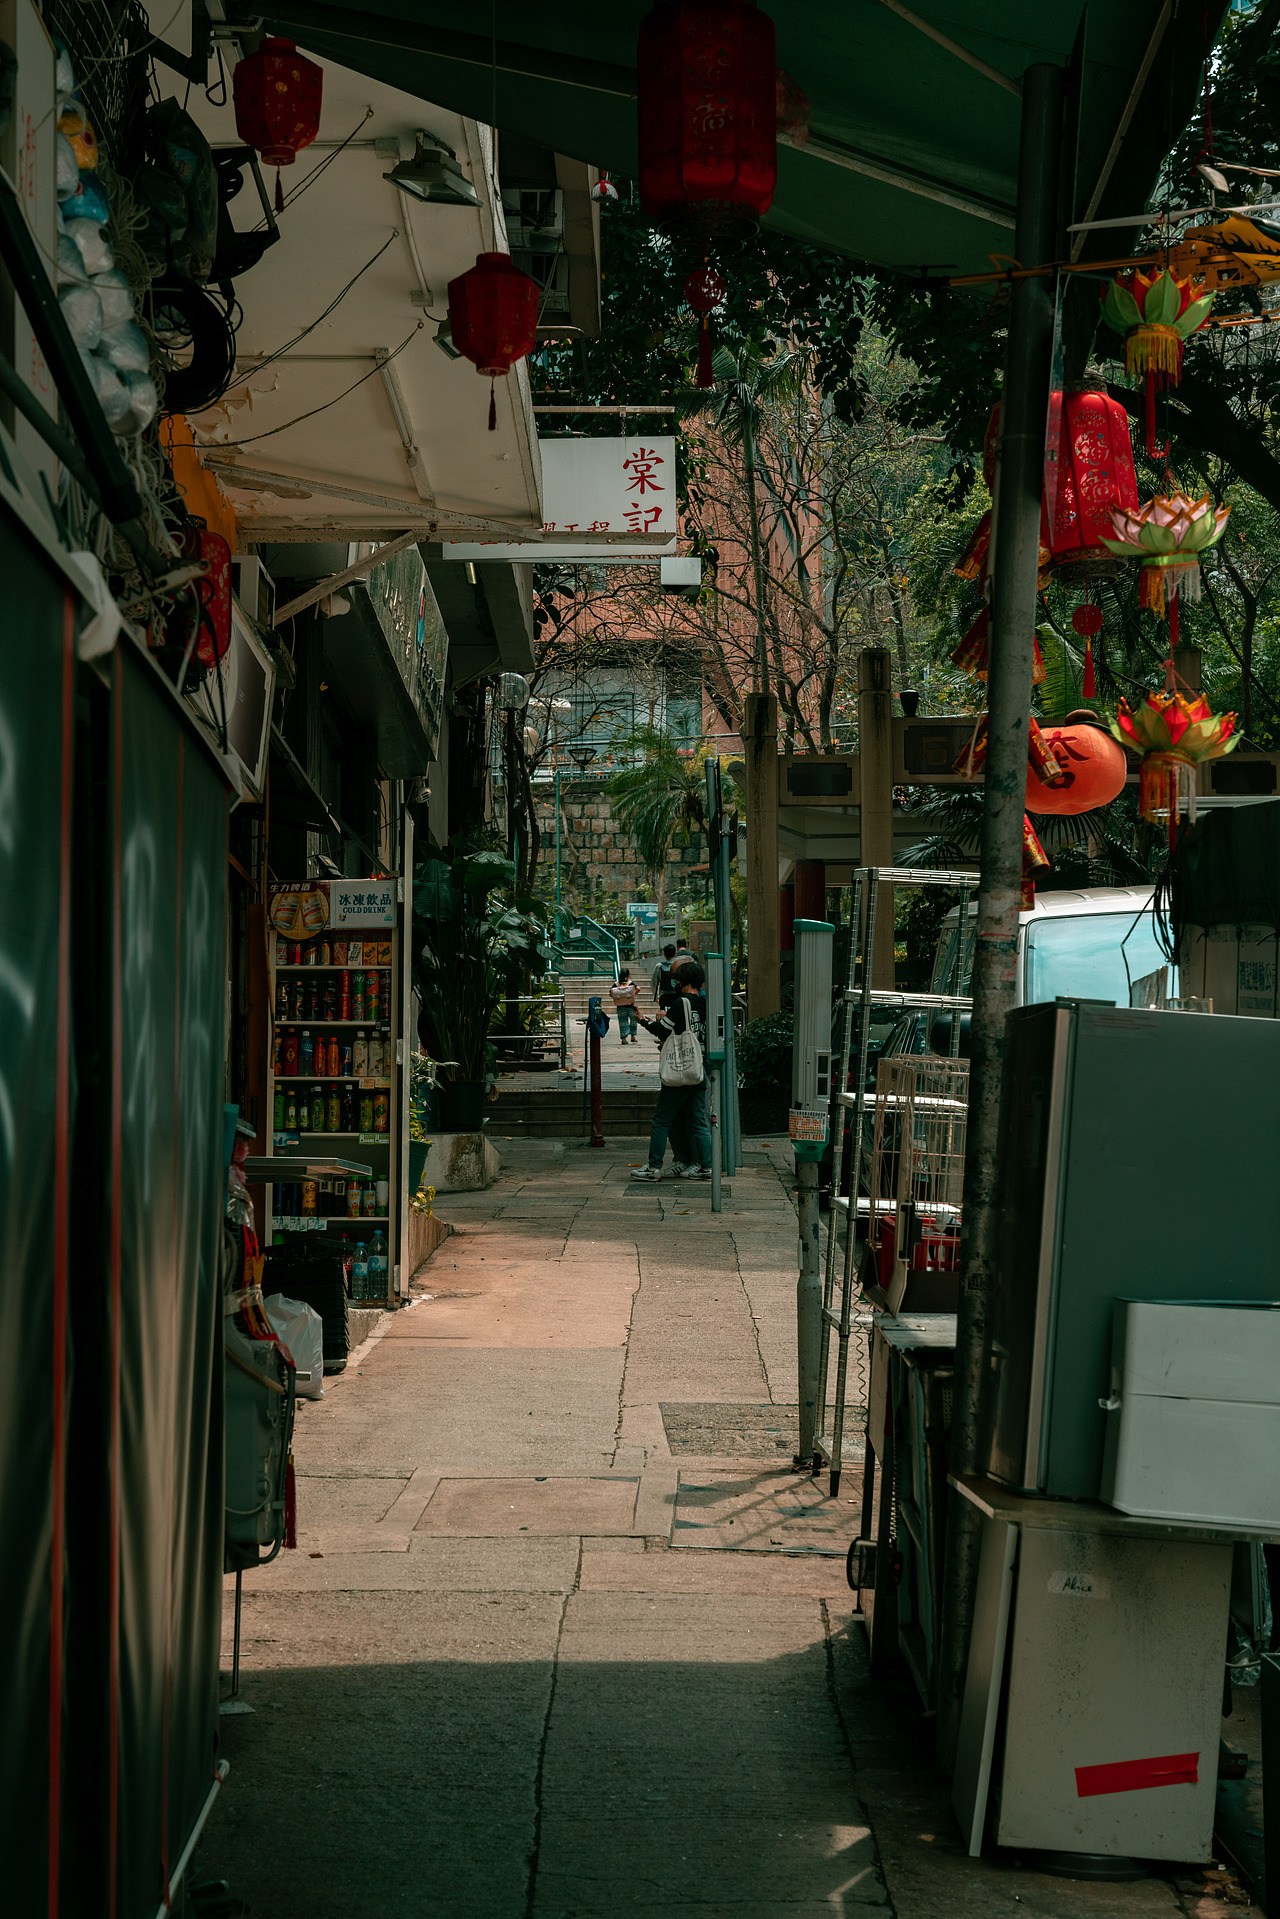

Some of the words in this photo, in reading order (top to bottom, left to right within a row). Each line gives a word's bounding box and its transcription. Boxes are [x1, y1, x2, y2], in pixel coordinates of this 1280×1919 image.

[339, 893, 392, 906] 冰凍飲品
[343, 906, 362, 914] COLD
[363, 906, 387, 914] DRINK
